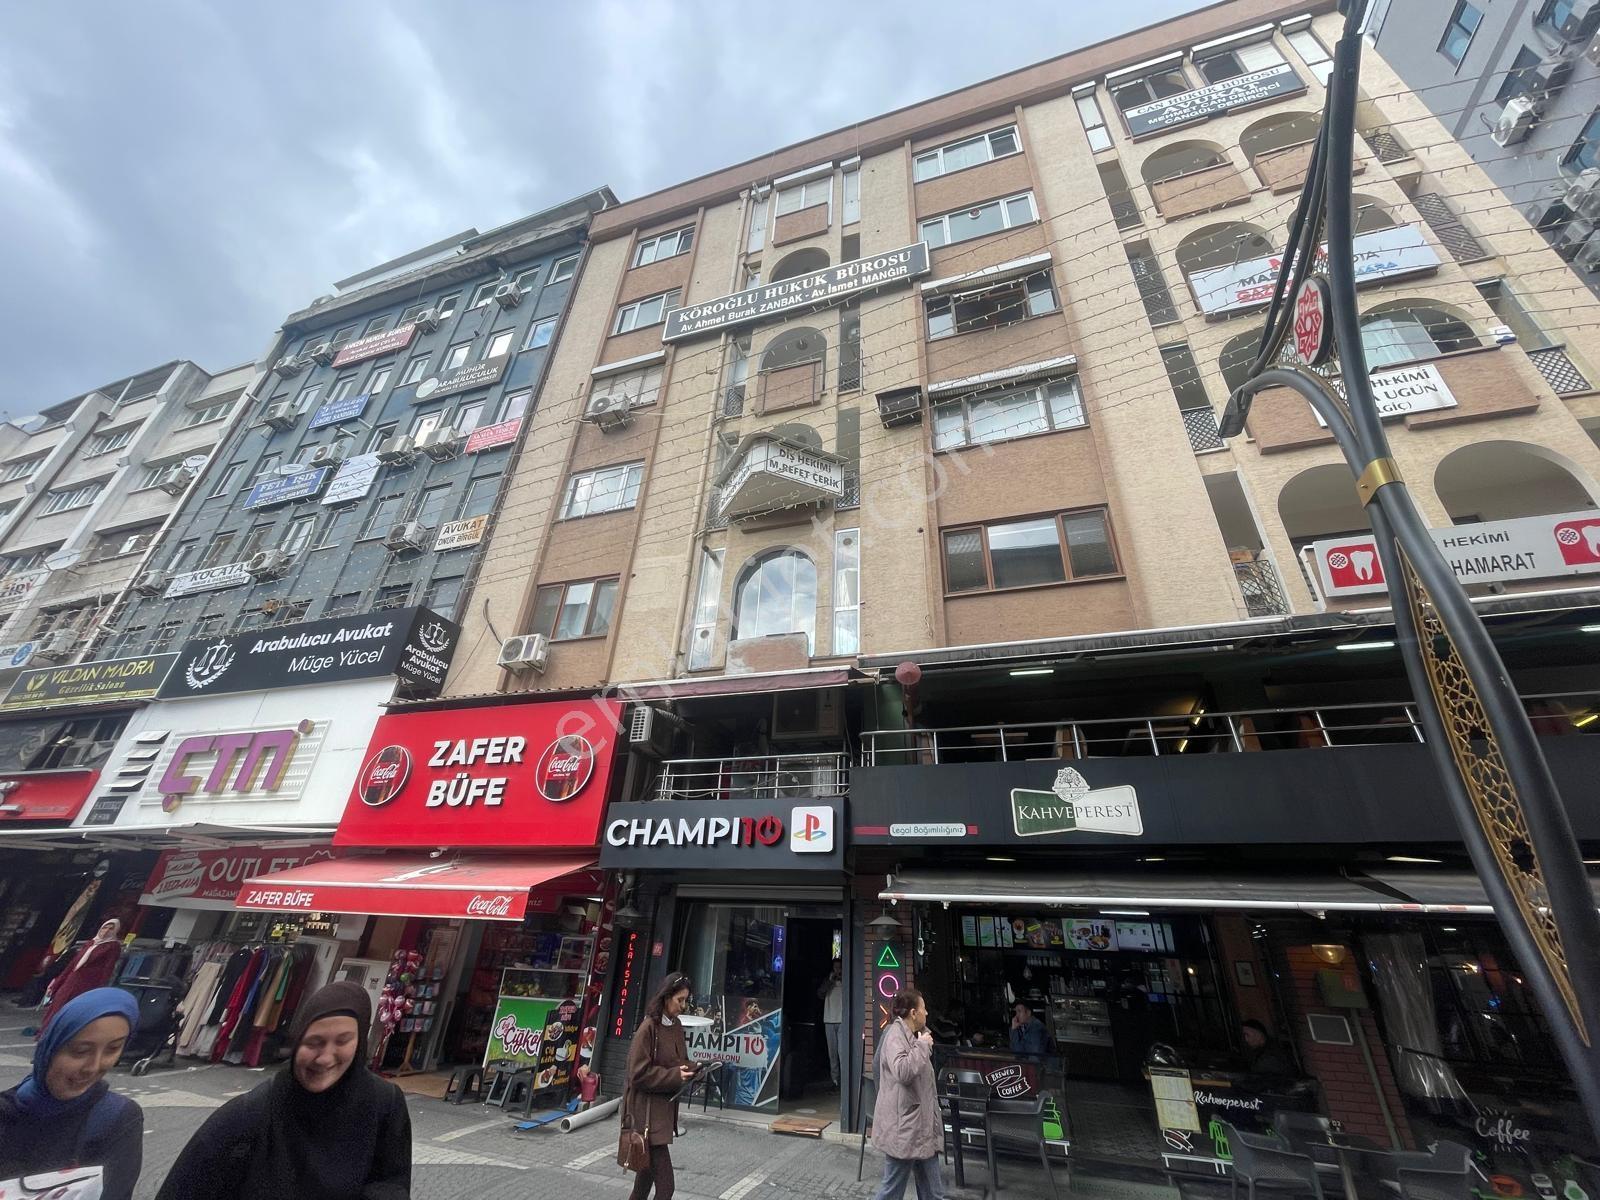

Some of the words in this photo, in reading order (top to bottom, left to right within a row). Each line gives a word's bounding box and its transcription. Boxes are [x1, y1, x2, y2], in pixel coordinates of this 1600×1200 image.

[1148, 106, 1198, 125] MEHMET
[1200, 98, 1228, 111] CAN
[1161, 82, 1260, 116] AVUKAT
[678, 291, 760, 323] KÖROĞLU
[764, 273, 828, 300] HUKUK
[836, 250, 911, 281] BÜROSU
[696, 317, 726, 330] Ahmet
[728, 307, 756, 321] Burak
[759, 294, 804, 313] ZANBAK
[443, 519, 486, 535] AVUKAT
[1443, 531, 1510, 548] HEKİMİ
[250, 632, 332, 654] Arabulucu
[332, 622, 395, 644] Avukat
[287, 654, 335, 674] Müge
[339, 646, 387, 665] Yücel
[405, 644, 449, 670] Arabulucu
[409, 655, 441, 675] Avukat
[102, 660, 156, 680] MADRA
[401, 661, 422, 675] Müge
[423, 670, 442, 684] Yücel
[428, 736, 526, 768] ZAFER
[426, 773, 508, 807] BÜFE
[245, 890, 282, 905] ZAFER
[282, 888, 314, 906] BÜFE
[615, 933, 637, 1036] PLAYSTATION
[684, 1031, 765, 1056] HAMPI10
[693, 1050, 711, 1060] OYUN
[713, 1053, 741, 1064] SALONU
[990, 1069, 1015, 1082] BREWED
[1001, 1083, 1023, 1096] COFFEE
[1193, 1090, 1264, 1110] Kahveperest
[1476, 1116, 1530, 1145] Coffee
